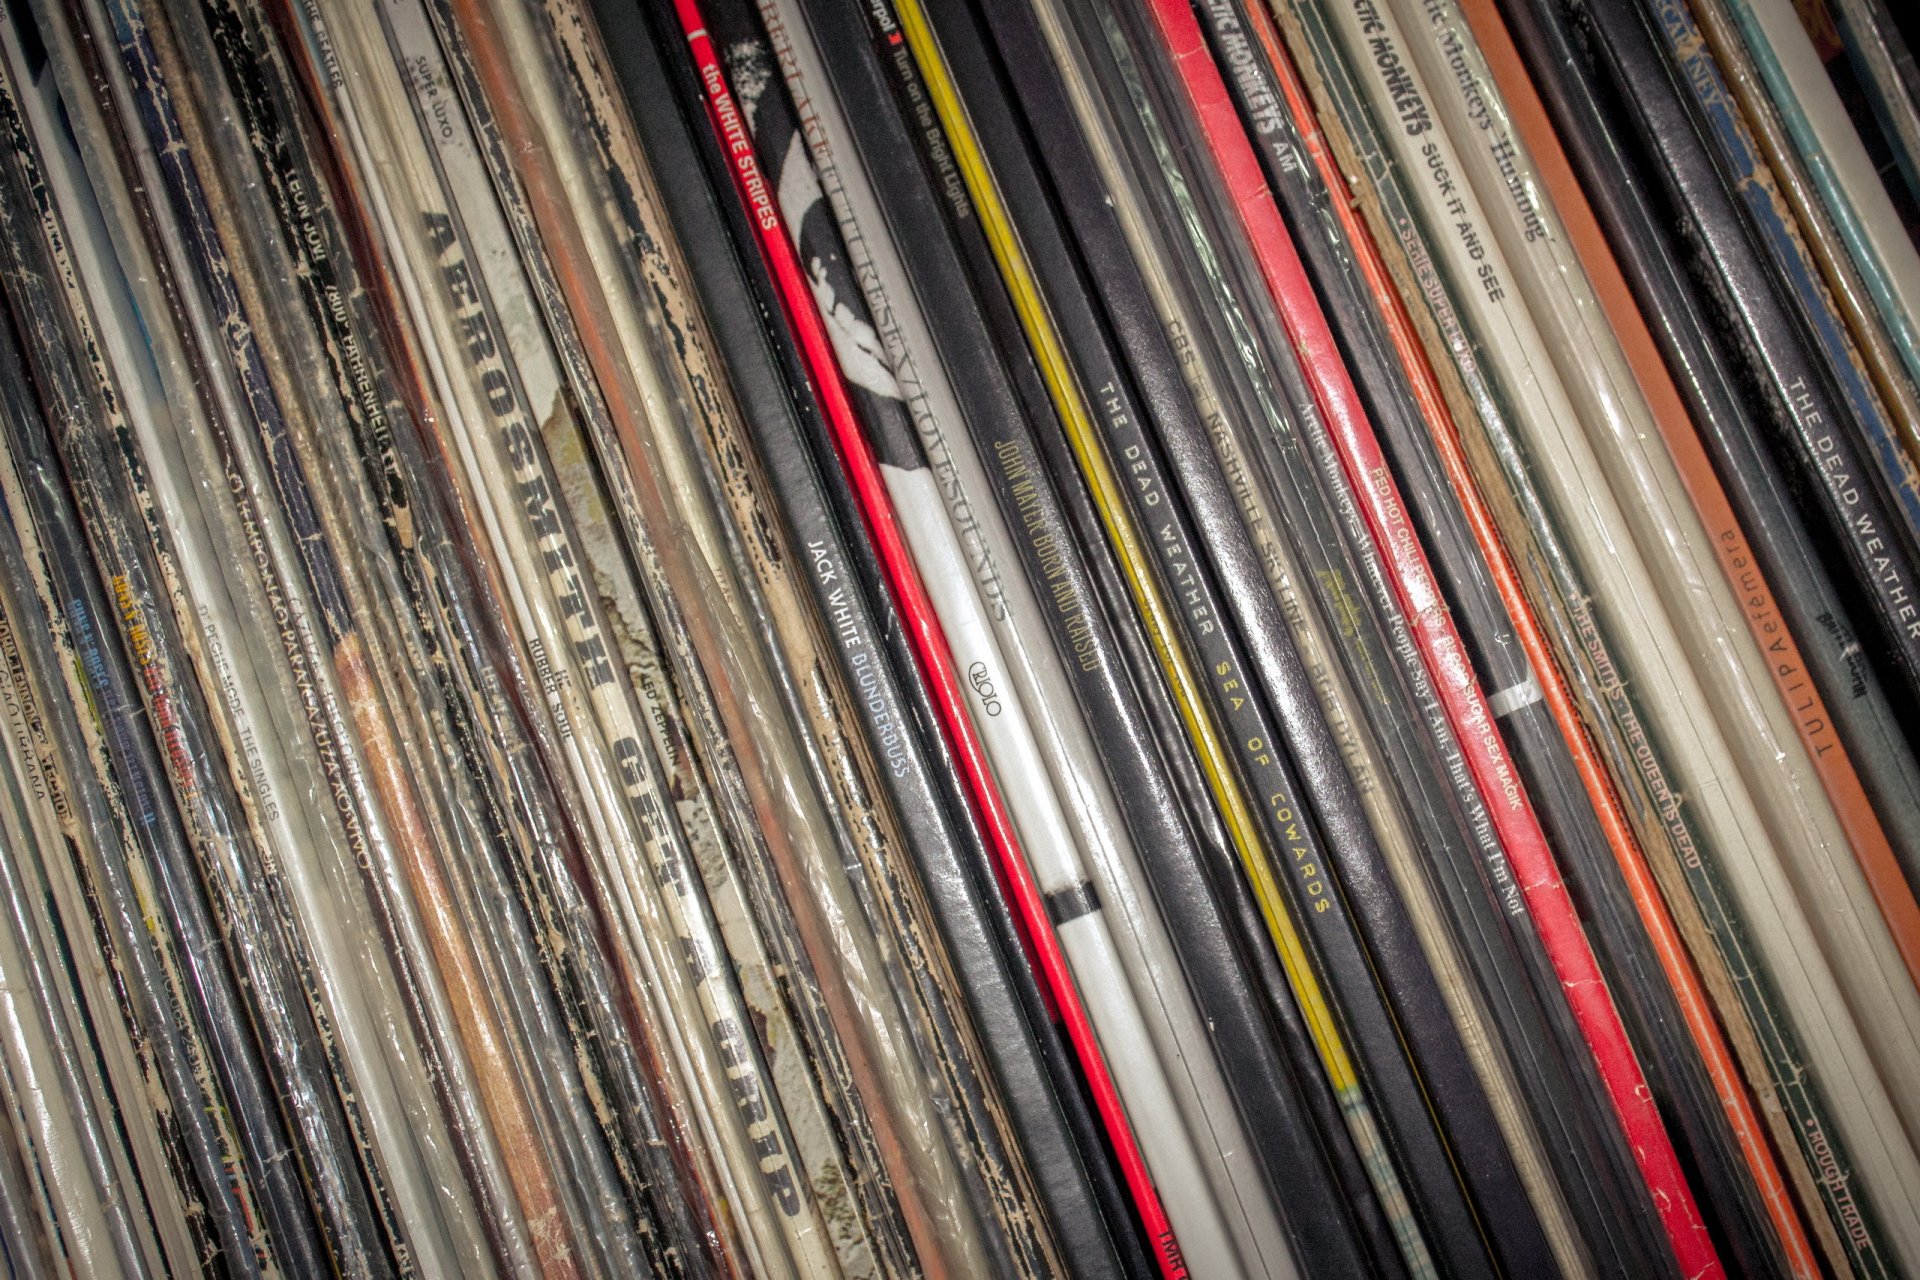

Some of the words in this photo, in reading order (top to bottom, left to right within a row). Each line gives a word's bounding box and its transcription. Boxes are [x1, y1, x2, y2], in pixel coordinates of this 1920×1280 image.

[700, 61, 725, 96] the
[891, 48, 915, 82] Turn
[905, 81, 923, 103] on
[1366, 31, 1433, 138] MONKEYS
[1432, 29, 1502, 134] Monkeys
[412, 54, 440, 99] SUPER
[429, 99, 456, 140] LUXO
[712, 92, 750, 154] WHITE
[914, 101, 936, 127] the
[1218, 27, 1286, 137] MONKEYS
[1270, 138, 1298, 173] AM
[923, 127, 953, 175] Bright
[1419, 141, 1457, 197] SUCK
[286, 177, 315, 221] BON
[735, 152, 780, 232] STRIPES
[942, 171, 972, 220] Lights
[1445, 196, 1466, 219] IT
[300, 219, 329, 263] JOVI
[1454, 218, 1487, 263] AND
[1423, 276, 1458, 330] SUPER
[1475, 262, 1506, 304] SEE
[1297, 399, 1330, 450] Arctic
[993, 434, 1027, 482] JOHN
[1010, 477, 1049, 536] MAYER
[1316, 451, 1361, 525] Monkeys
[1787, 376, 1822, 428] THE
[1816, 435, 1860, 507] DEAD
[1853, 513, 1920, 640] WEATHER
[1031, 531, 1067, 581] BORN
[1165, 318, 1196, 367] CBS
[1205, 411, 1267, 535] NASHVILLE
[1259, 540, 1308, 637] SKYLINE
[1309, 661, 1341, 712] BOB
[1333, 718, 1375, 795] DYLAN
[1050, 577, 1080, 615] AND
[288, 594, 324, 669] CAZUZ
[805, 536, 838, 586] JACK
[823, 587, 863, 650] WHITE
[849, 650, 913, 780] BLUNDERBUSS
[1064, 611, 1103, 674] RAISED
[1098, 381, 1128, 429] THE
[1123, 444, 1160, 508] DEAD
[1157, 524, 1215, 636] WEATHER
[1214, 660, 1247, 711] SEA
[1245, 735, 1270, 768] OF
[1268, 791, 1331, 914] COWARDS
[1370, 467, 1392, 497] RED
[1383, 496, 1406, 527] HOT
[1395, 526, 1422, 563] CHILI
[1461, 685, 1491, 735] SUGAR
[1481, 733, 1505, 765] SEX
[1495, 764, 1524, 811] MAGIK
[1385, 613, 1421, 670] People
[418, 201, 620, 693] AEROSMITH
[608, 733, 692, 904] GET
[674, 928, 717, 988] A
[709, 1012, 810, 1222] GRIP
[527, 637, 558, 696] RUBBER
[550, 700, 576, 744] SOUL
[1407, 668, 1432, 701] Say
[1423, 699, 1439, 712] I
[196, 603, 230, 673] DPECHE
[219, 673, 245, 719] MODE
[238, 726, 258, 757] THE
[248, 757, 281, 823] SINGLES
[638, 673, 659, 702] LED
[649, 701, 685, 768] ZEPPELIN
[1426, 711, 1455, 751] Am,
[1570, 603, 1596, 639] THE
[1586, 637, 1624, 702] SMITHS
[1618, 709, 1644, 744] THE
[1634, 743, 1670, 804] QUEEN
[1661, 802, 1679, 822] IS
[1670, 822, 1701, 871] DEAD
[1444, 750, 1477, 803] That's
[1467, 804, 1497, 851] What
[1486, 850, 1512, 884] I'm
[1501, 883, 1526, 918] Not
[1807, 1129, 1846, 1193] ROUGH
[1835, 1192, 1873, 1251] TRADE
